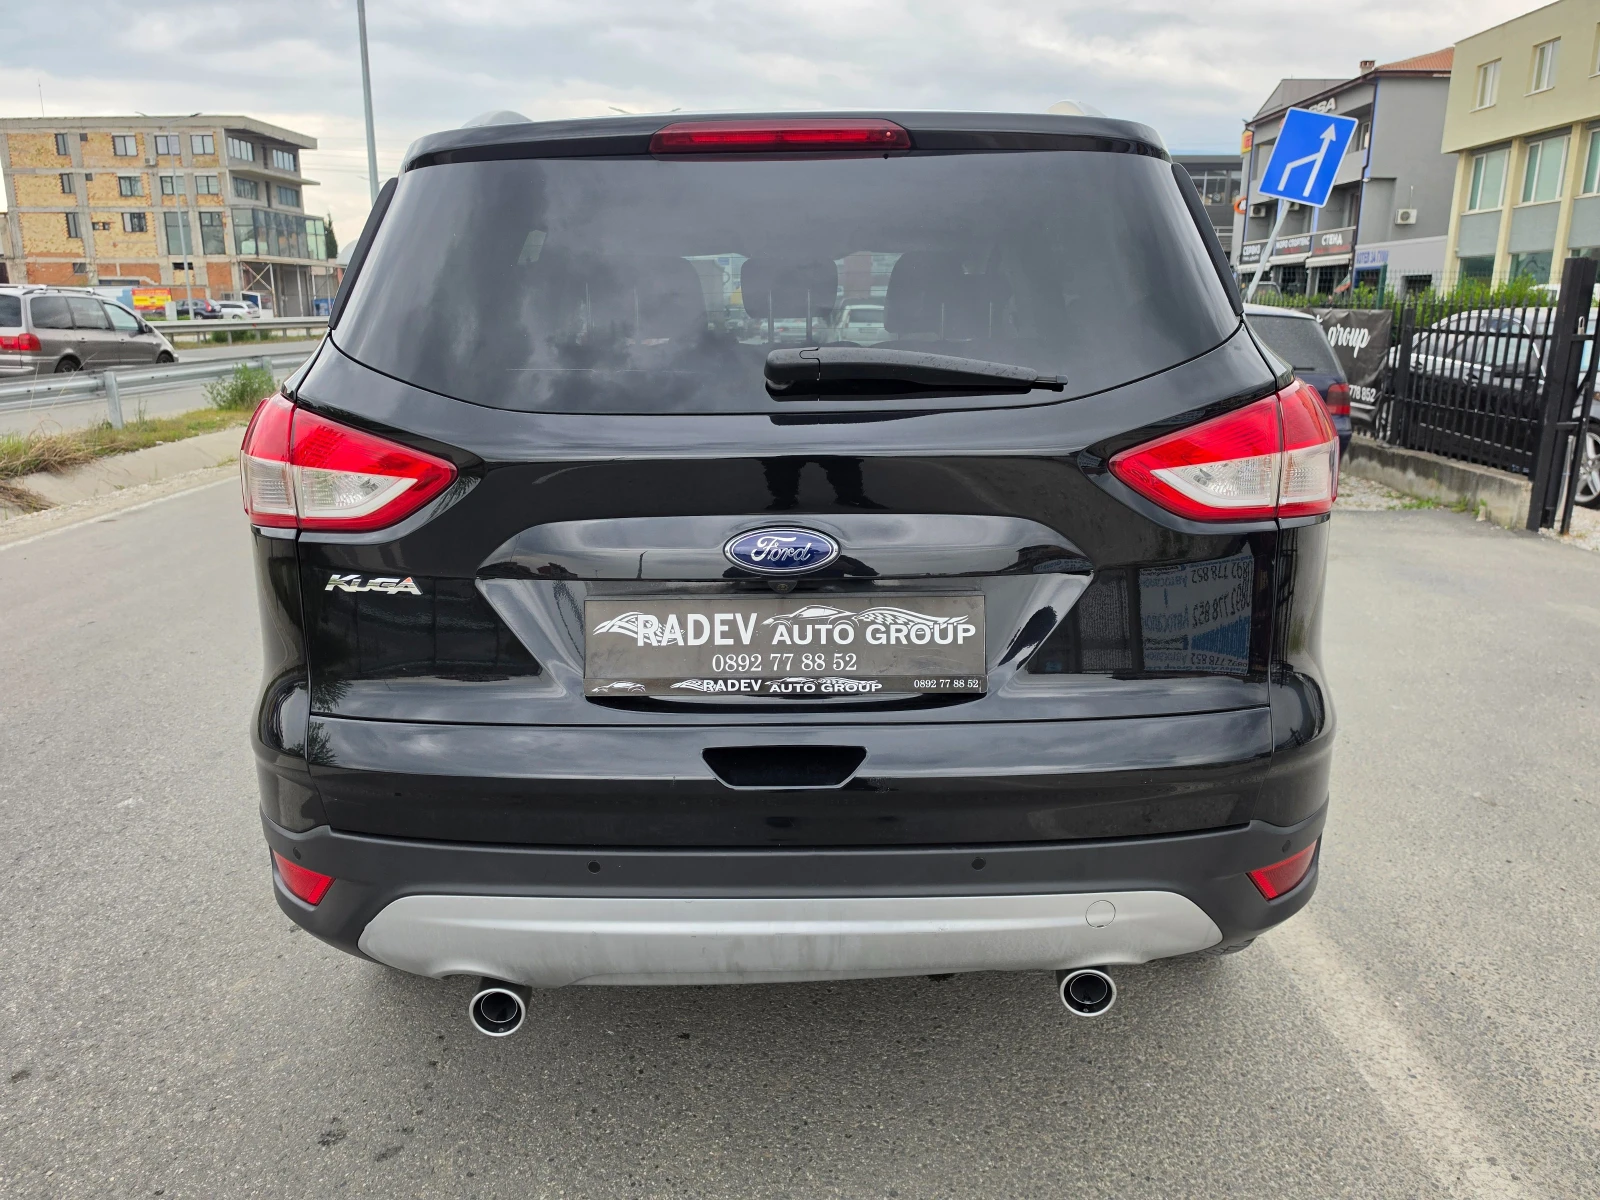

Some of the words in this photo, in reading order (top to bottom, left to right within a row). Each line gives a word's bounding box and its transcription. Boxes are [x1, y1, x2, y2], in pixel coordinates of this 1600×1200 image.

[1361, 386, 1377, 403] 852
[751, 536, 813, 561] Ford
[324, 574, 423, 596] KUGA
[637, 612, 758, 647] RADEV
[771, 623, 855, 645] AUTO
[865, 623, 976, 645] GROUP
[712, 653, 762, 672] 0892
[769, 653, 794, 672] 77
[801, 653, 826, 671] 88
[833, 653, 857, 671] 52
[703, 679, 762, 693] RADEV
[769, 683, 816, 693] AUTO
[821, 683, 882, 693] GROUP
[913, 679, 937, 688] 0892
[939, 680, 951, 688] 77
[953, 680, 965, 688] 88
[967, 680, 979, 688] 52
